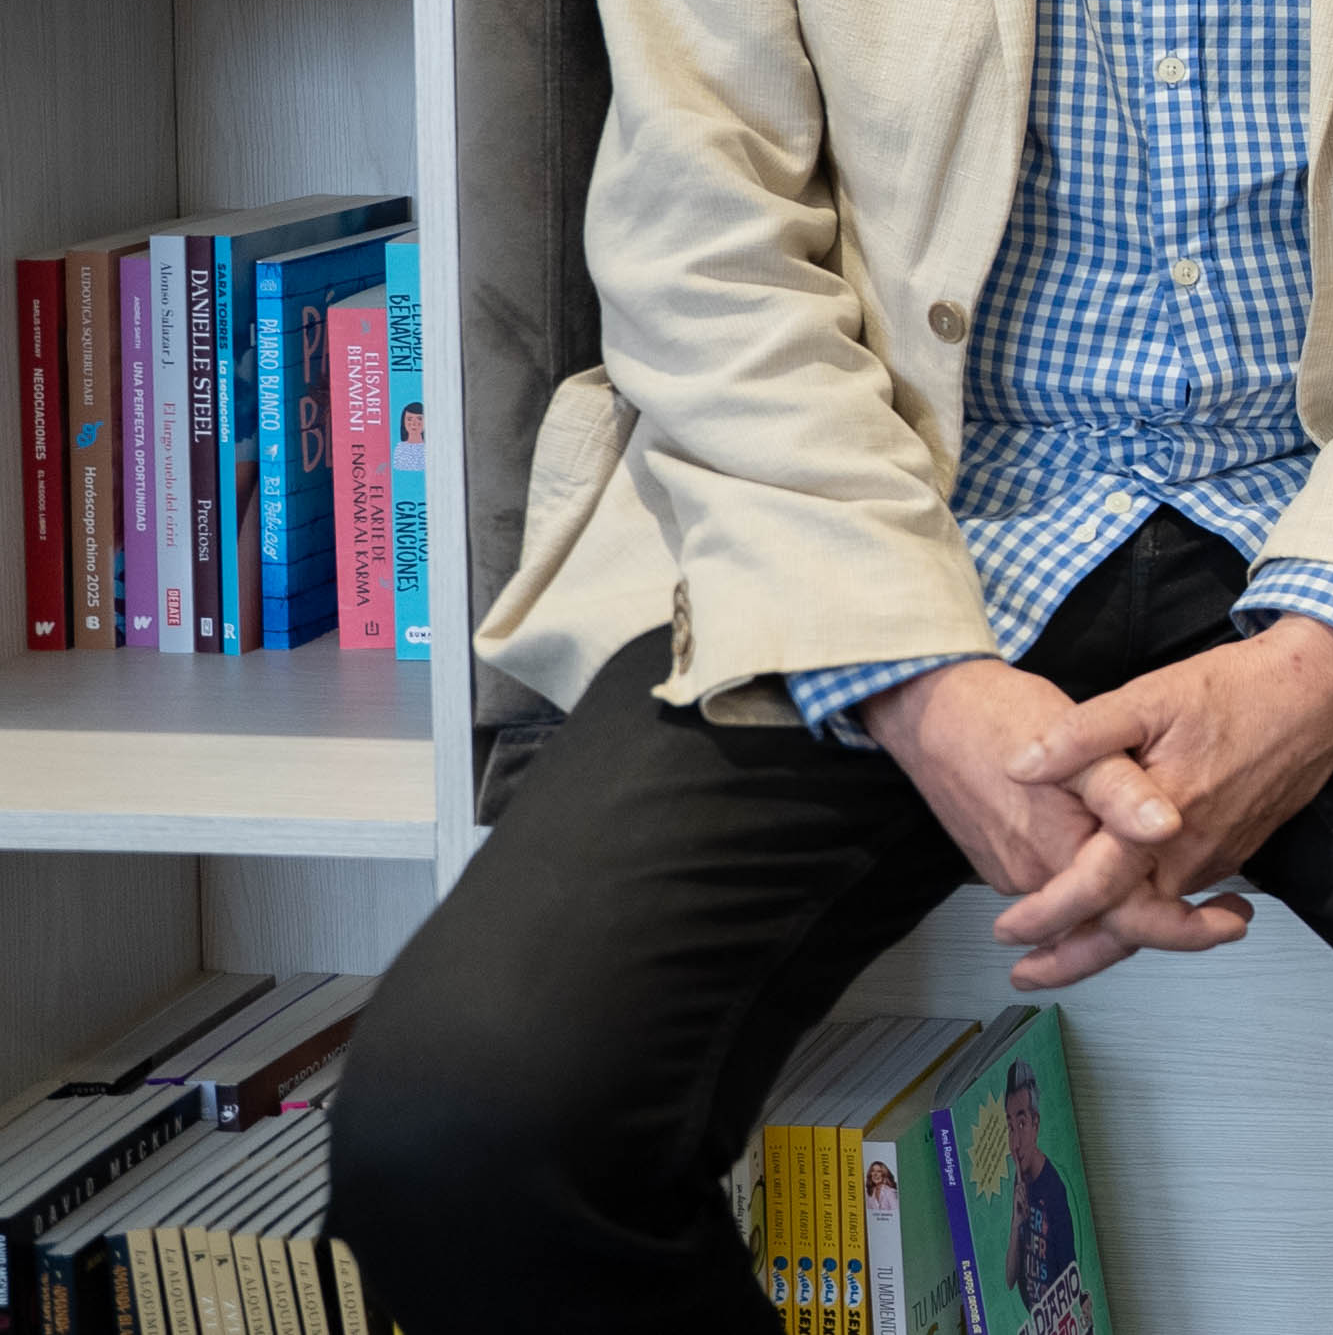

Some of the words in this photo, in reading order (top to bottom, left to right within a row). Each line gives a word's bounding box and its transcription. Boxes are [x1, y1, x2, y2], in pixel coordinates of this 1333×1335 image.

[81, 265, 92, 325] LUDOVICA
[159, 262, 174, 306] Alonso
[217, 264, 226, 297] SARA
[160, 308, 175, 355] Salazar
[190, 269, 211, 371] DANIELLE
[218, 302, 227, 349] TORRES
[389, 293, 411, 374] BENAVENT
[81, 326, 93, 377] SQUIRRU
[258, 318, 280, 370] PÁJARO
[82, 379, 94, 407] DARI
[132, 361, 145, 384] UNA
[346, 345, 365, 432] BENAVENT
[364, 352, 384, 426] ELÍSABET
[32, 368, 47, 461] NEGOCIACIONES
[133, 387, 146, 446] PERFECTA
[163, 402, 177, 417] El
[193, 377, 213, 443] STEEL
[220, 377, 231, 444] seducción
[259, 375, 280, 431] BLANCO
[161, 419, 177, 452] largo
[134, 449, 146, 532] OPORTUNIDAD
[164, 455, 178, 489] vuelo
[350, 444, 369, 522] ENGAÑAR
[369, 486, 385, 505] EL
[82, 466, 99, 530] Horóscopo
[165, 492, 178, 512] del
[195, 499, 213, 562] Preciosa
[353, 524, 369, 545] AL
[370, 505, 385, 542] ARTE
[395, 501, 420, 593] CANCIONES
[86, 533, 99, 572] chino
[372, 545, 386, 565] DE
[86, 575, 100, 608] 2025
[354, 550, 371, 607] KARMA
[167, 589, 181, 625] DEBATE
[941, 1128, 949, 1144] Ami
[877, 1265, 893, 1280] TU
